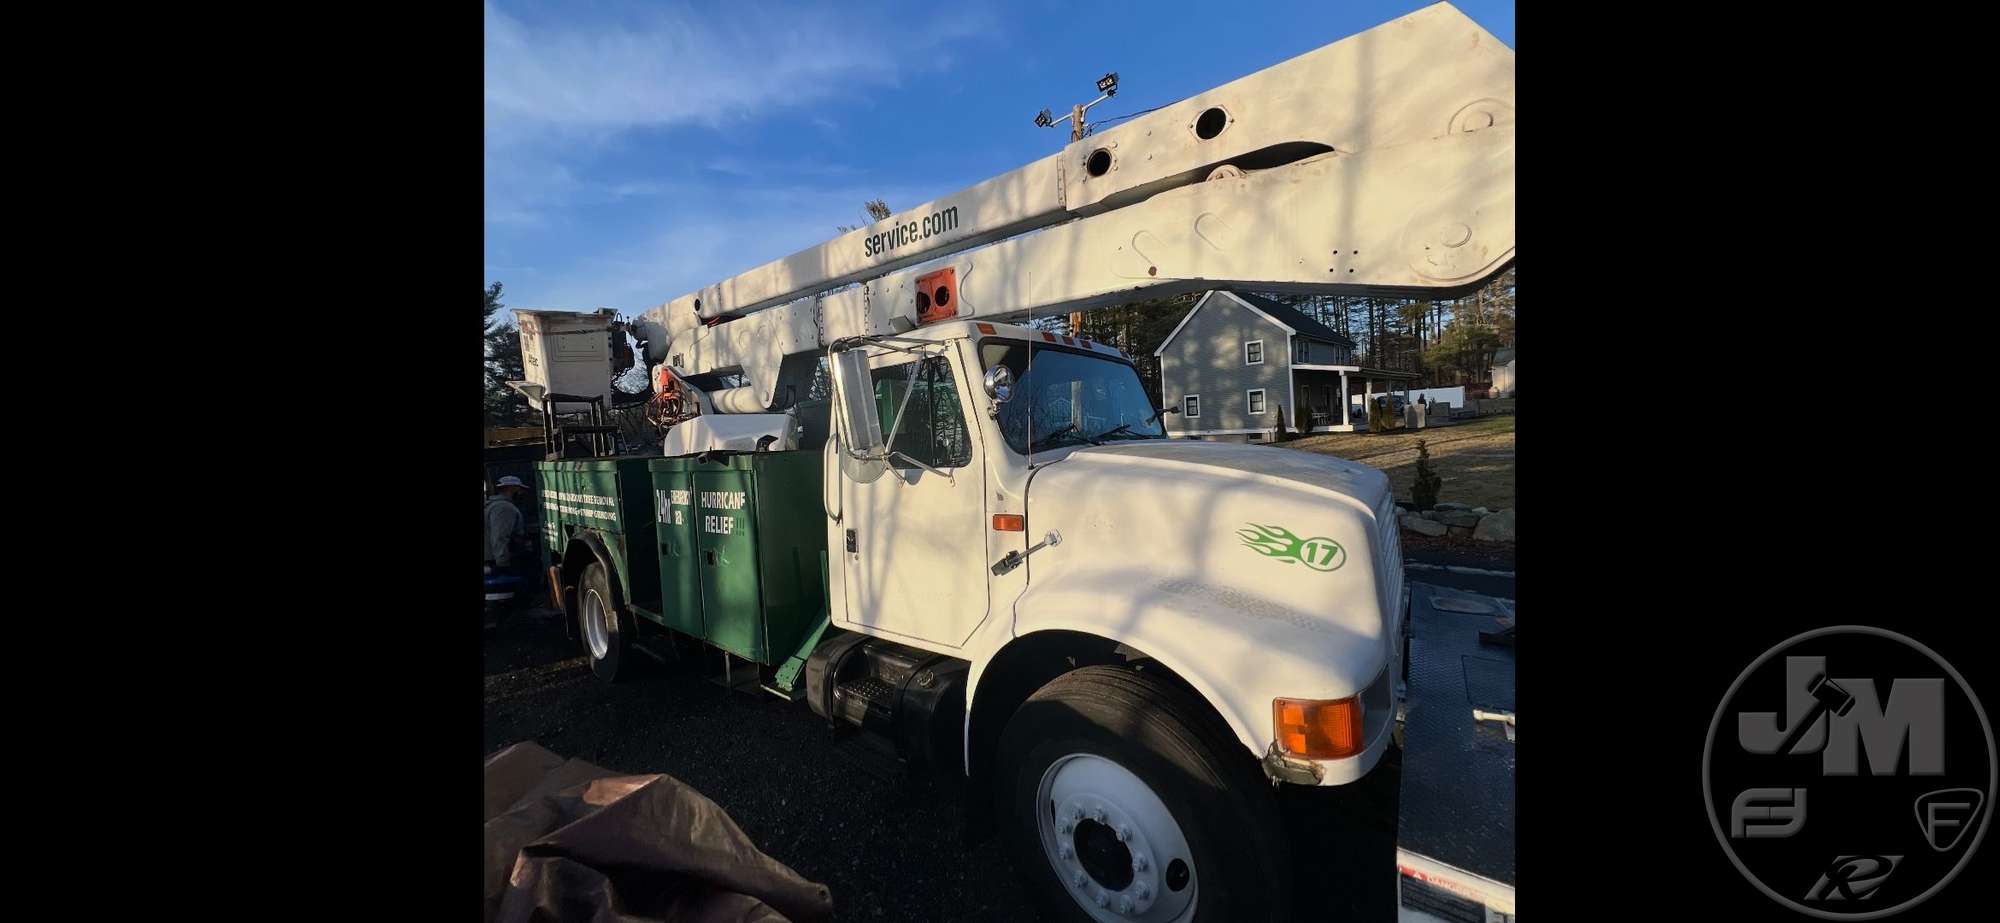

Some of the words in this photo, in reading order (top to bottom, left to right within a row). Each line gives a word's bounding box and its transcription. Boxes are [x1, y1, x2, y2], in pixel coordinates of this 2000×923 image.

[865, 206, 959, 257] service.com
[705, 515, 733, 535] RELIEF
[1306, 542, 1338, 566] 17
